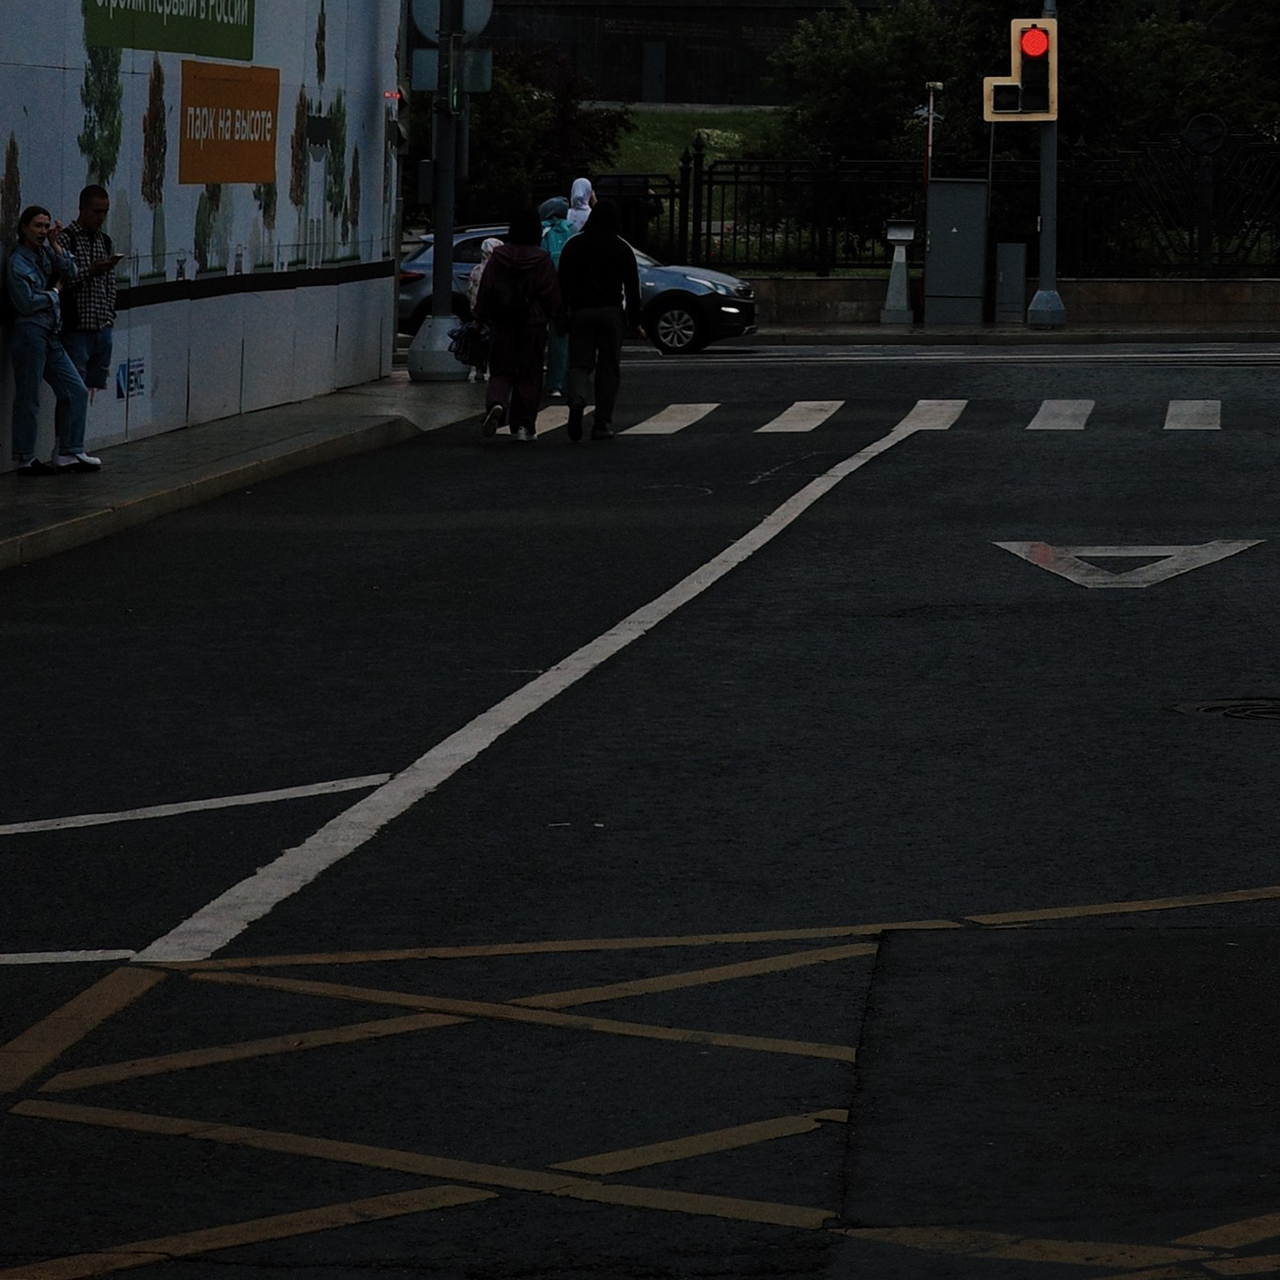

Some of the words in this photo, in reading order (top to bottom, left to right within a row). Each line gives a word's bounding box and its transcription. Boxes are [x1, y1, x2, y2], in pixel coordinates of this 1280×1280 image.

[186, 105, 216, 150] парк
[218, 107, 232, 141] на
[234, 108, 273, 142] высоте
